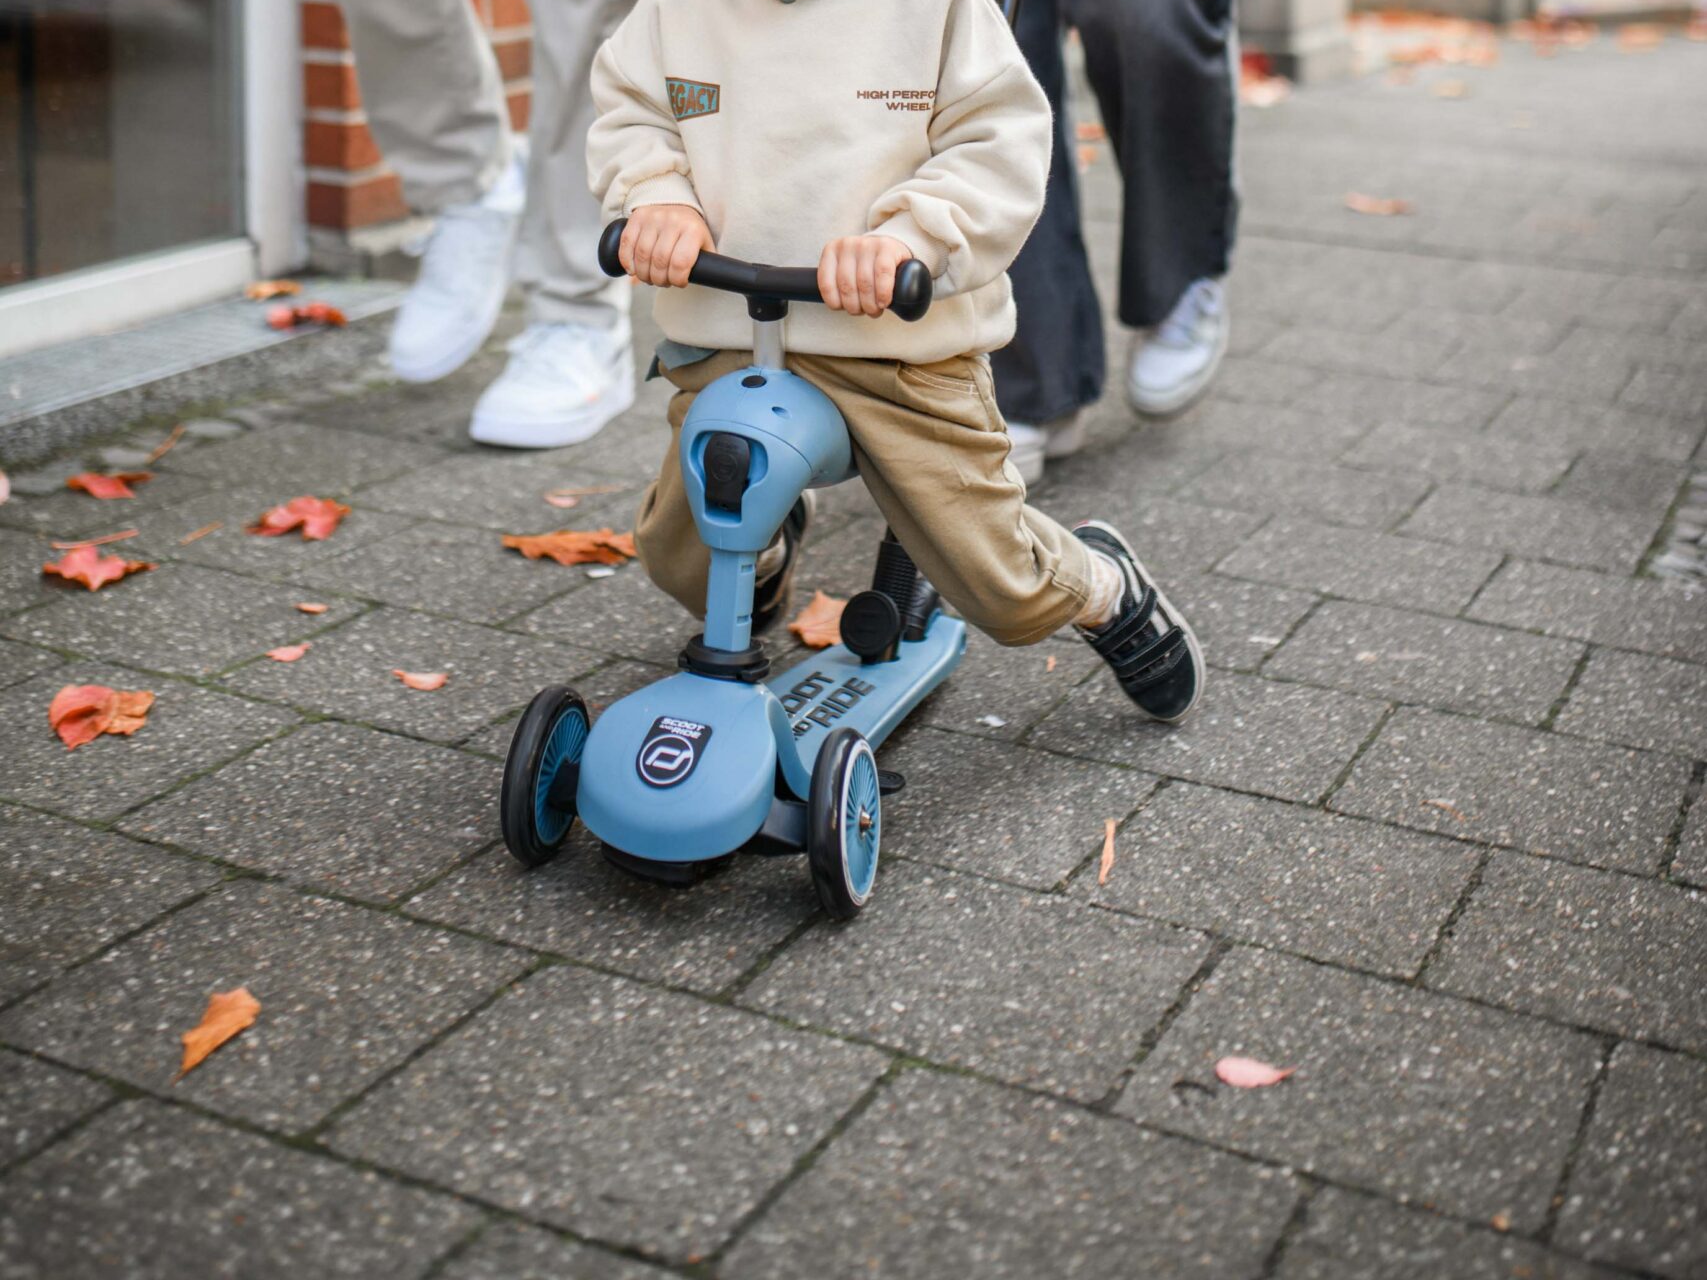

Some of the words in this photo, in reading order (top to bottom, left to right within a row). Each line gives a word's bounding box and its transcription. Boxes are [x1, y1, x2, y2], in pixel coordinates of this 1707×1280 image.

[857, 90, 889, 99] HIGH
[892, 90, 936, 99] PERFO
[806, 677, 876, 728] RIDE
[661, 718, 705, 731] SCOOT
